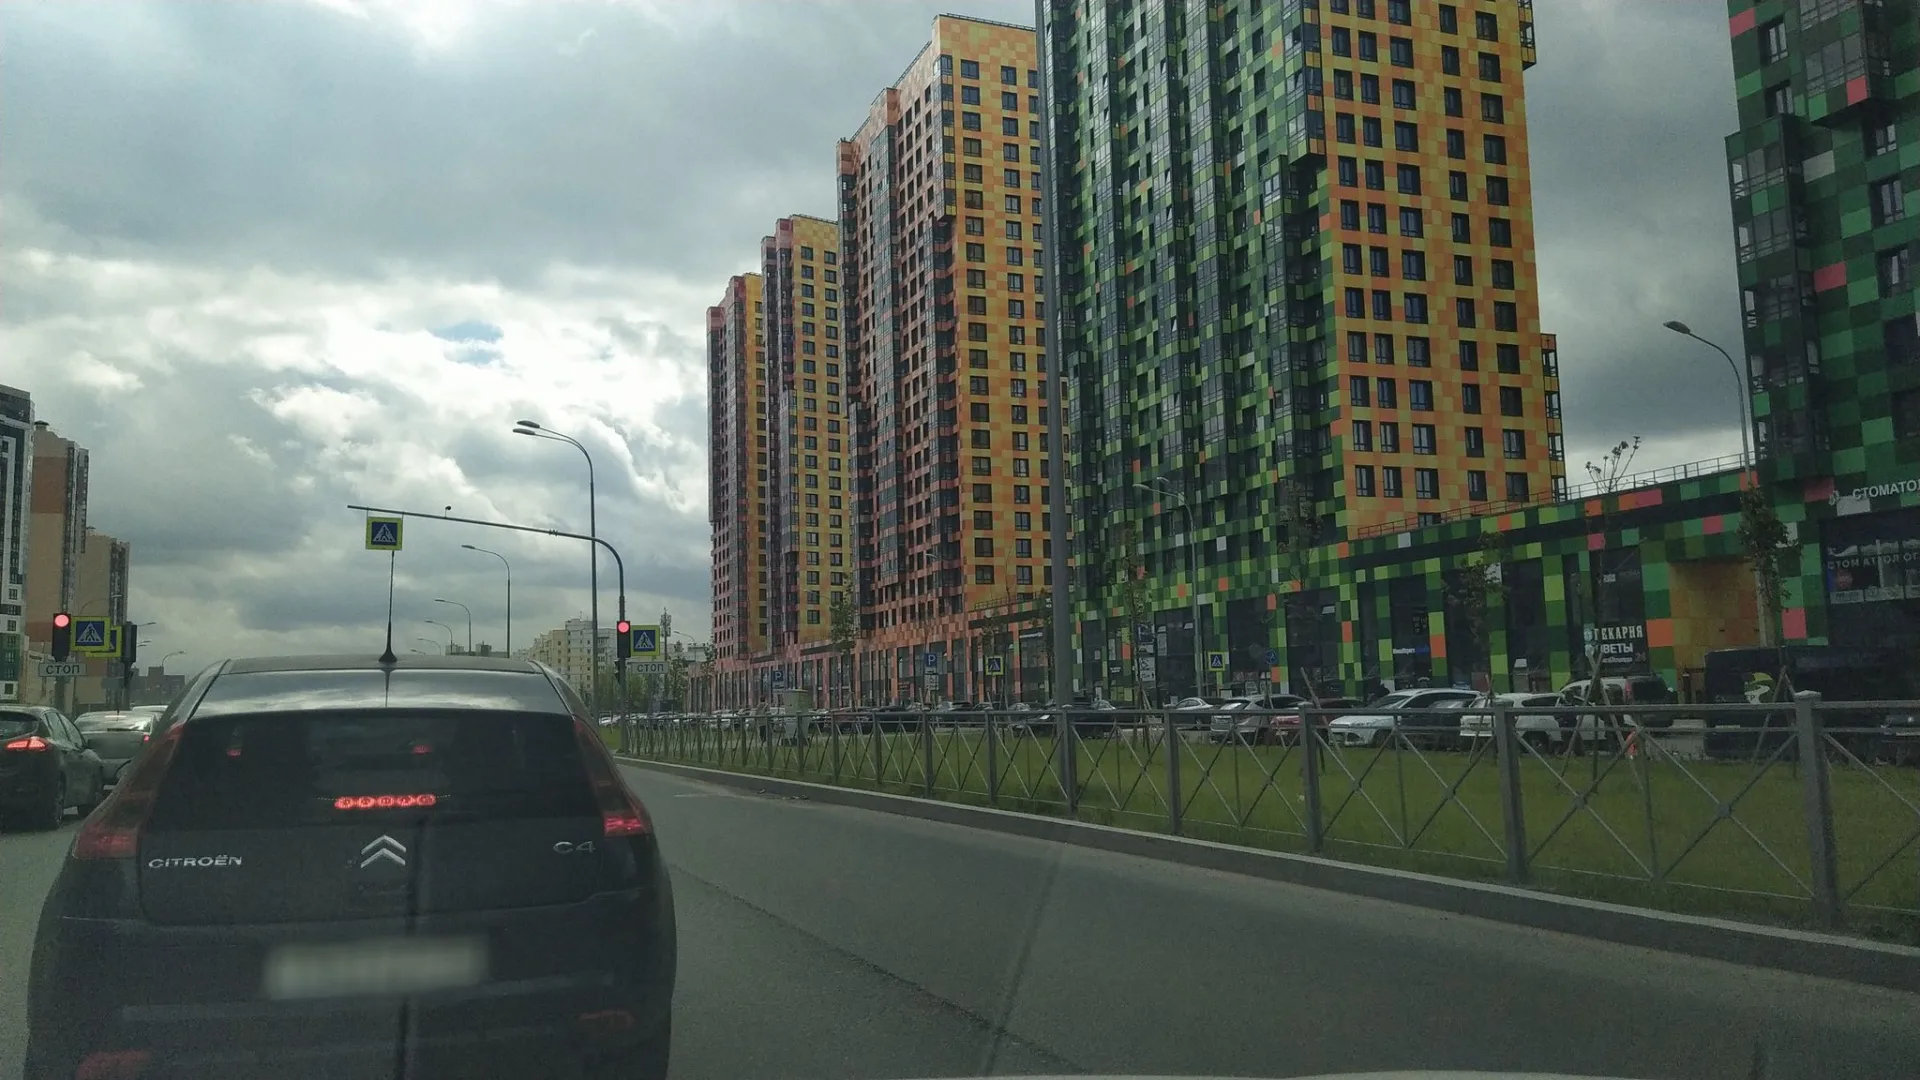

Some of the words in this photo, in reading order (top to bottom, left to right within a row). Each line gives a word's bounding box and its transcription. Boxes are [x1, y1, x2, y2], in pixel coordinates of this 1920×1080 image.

[45, 663, 80, 675] СТОП
[636, 663, 665, 673] СТОП
[553, 840, 596, 854] C4
[148, 853, 242, 869] CITROËN
